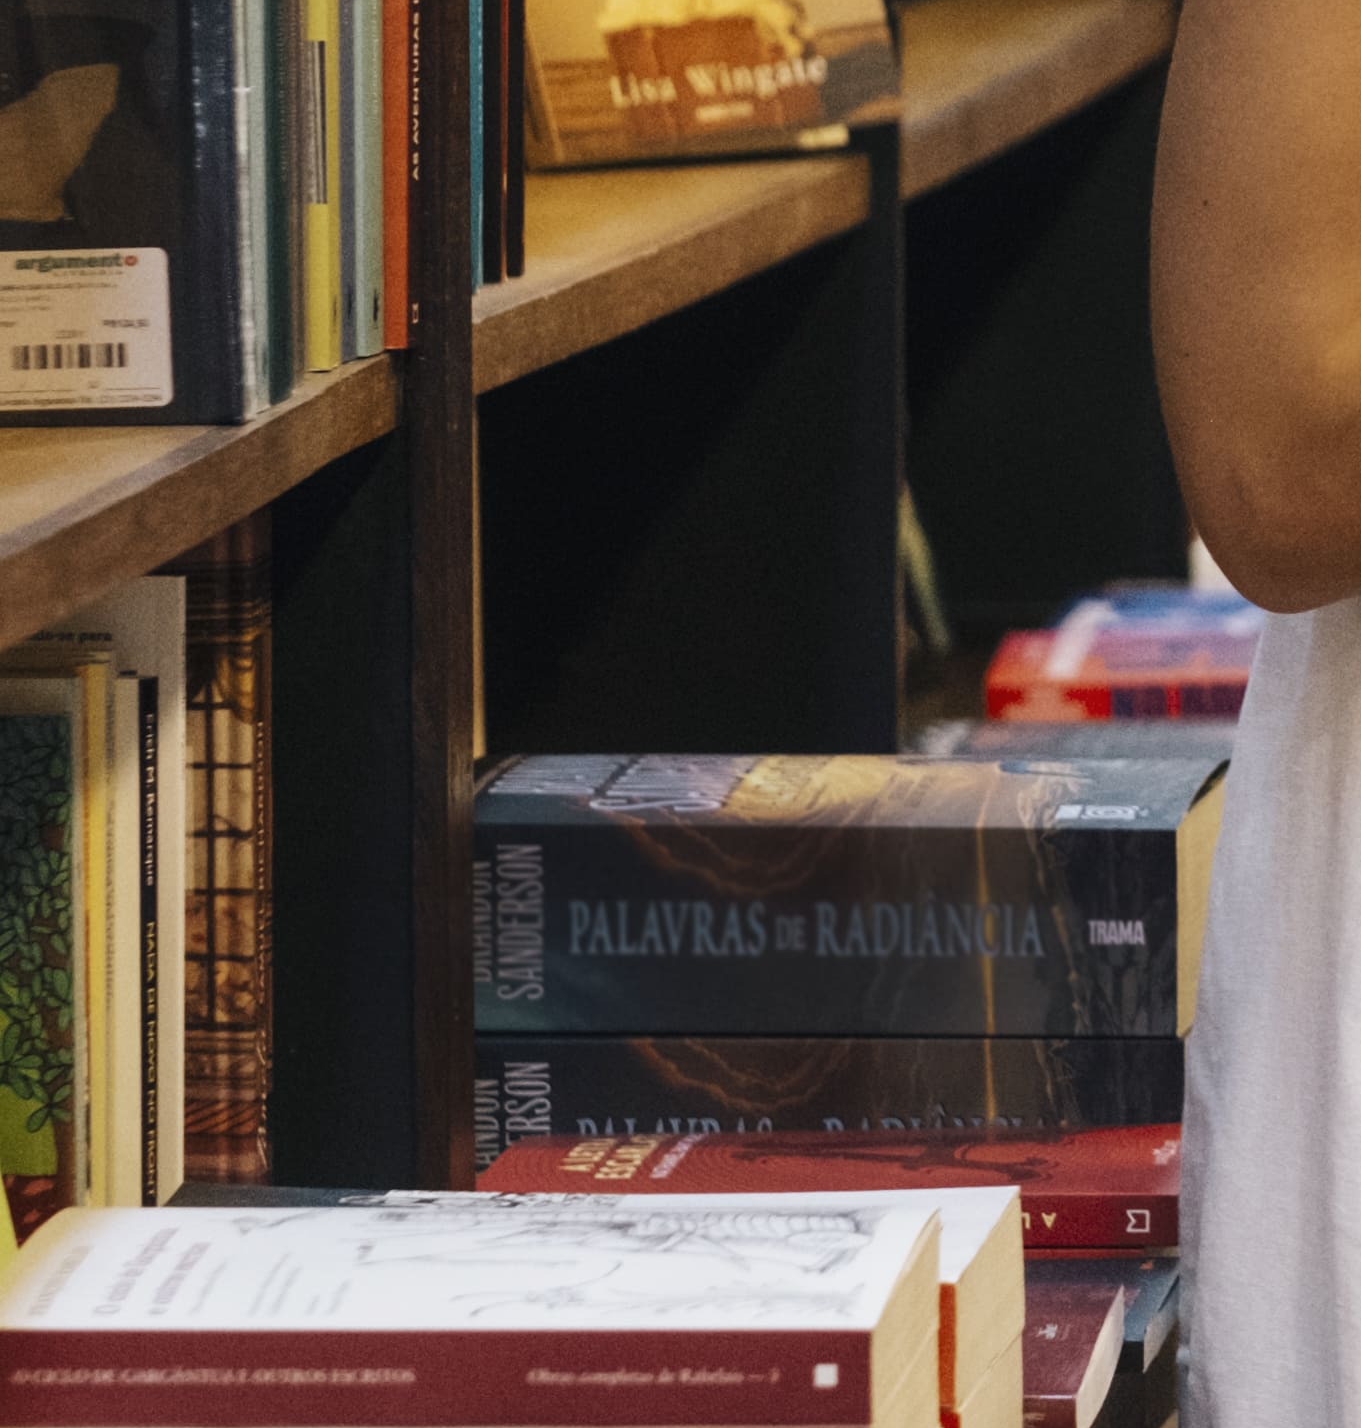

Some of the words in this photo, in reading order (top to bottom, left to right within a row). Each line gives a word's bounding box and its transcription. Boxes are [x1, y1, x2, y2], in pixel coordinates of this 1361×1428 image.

[412, 12, 421, 144] AVENTURAS
[608, 72, 678, 110] Lisa
[685, 55, 828, 100] Wingate
[412, 151, 421, 181] AS
[15, 253, 138, 272] argumento
[145, 713, 156, 761] Erich
[145, 793, 156, 888] Remarque
[496, 843, 546, 1001] SANDERSON
[568, 899, 768, 957] PALAVRAS
[775, 915, 805, 951] DE
[814, 889, 1046, 958] RADIÂNCIA
[1088, 919, 1146, 946] TRAMA
[146, 921, 156, 983] NADA
[146, 988, 156, 1015] DE
[147, 1021, 156, 1084] NOVO
[147, 1090, 156, 1124] NO
[147, 1129, 157, 1196] FRONT
